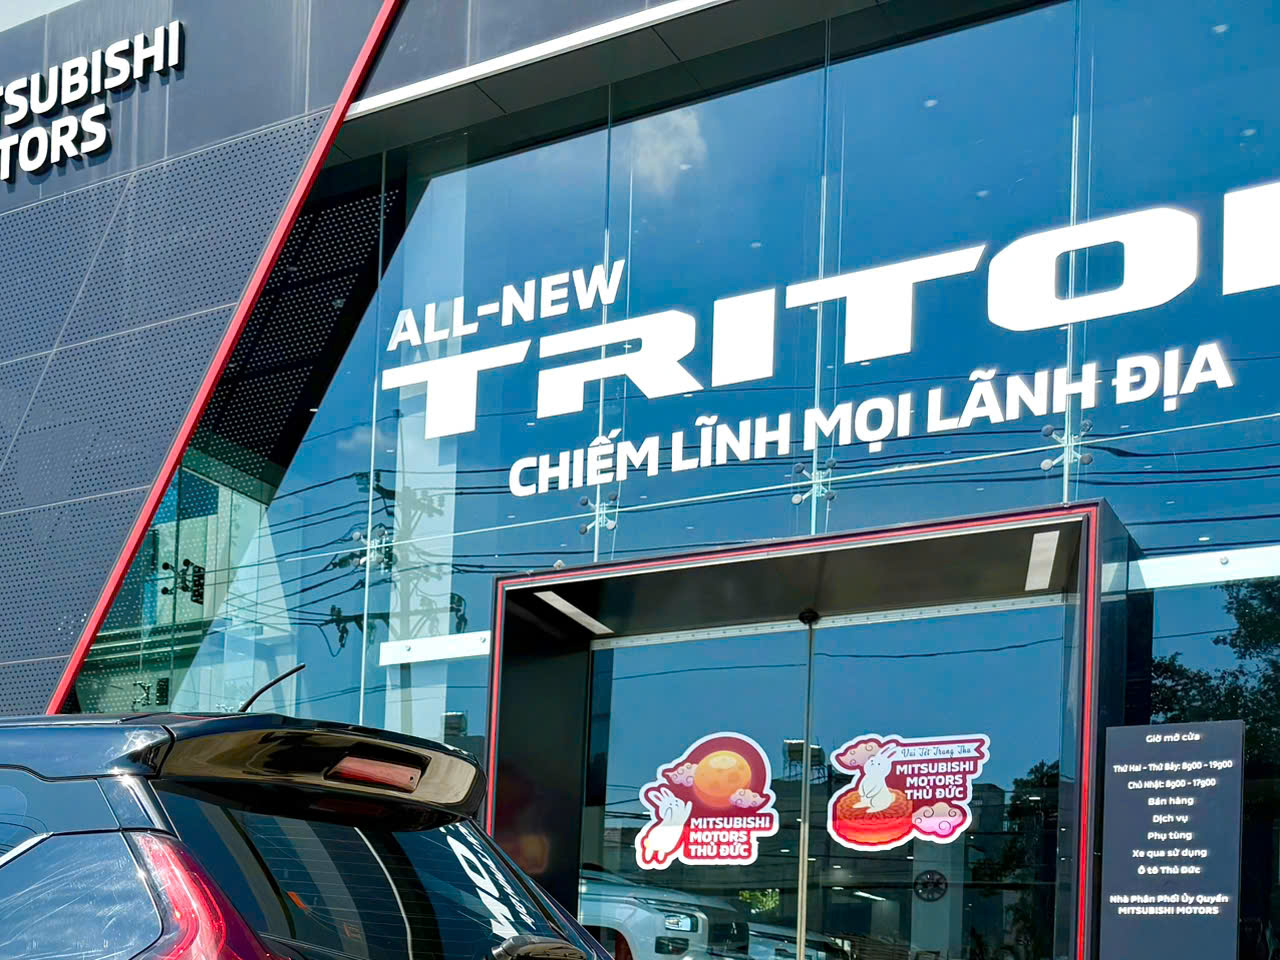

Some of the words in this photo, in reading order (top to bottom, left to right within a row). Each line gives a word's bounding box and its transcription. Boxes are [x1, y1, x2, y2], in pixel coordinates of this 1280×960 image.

[382, 180, 1280, 440] TRITO
[387, 259, 625, 351] ALL-NEW
[509, 428, 659, 497] CHIẾM
[671, 415, 791, 472] LĨNH
[804, 393, 911, 453] MỌI
[927, 368, 1098, 433] LÃNH
[1112, 342, 1235, 413] ĐỊA
[896, 761, 974, 775] MITSUBISHI
[1129, 764, 1142, 772] Hai
[1209, 760, 1233, 770] 19g00
[906, 775, 963, 787] MOTORS
[1192, 778, 1216, 788] 17g00
[905, 785, 932, 800] THỦ
[935, 785, 964, 799] ĐỨC
[1148, 797, 1167, 806] Bán
[1169, 796, 1195, 806] hàng
[691, 816, 770, 829] MITSUBISHI
[1152, 814, 1174, 824] Dịch
[1176, 815, 1189, 823] vụ
[690, 831, 748, 842] MOTORS
[1147, 832, 1167, 841] Phụ
[1168, 831, 1193, 841] tùng
[688, 841, 717, 856] THỦ
[720, 841, 749, 856] ĐỨC
[1146, 850, 1165, 858] qua
[1167, 848, 1181, 857] sử
[1181, 848, 1207, 858] dụng
[1147, 866, 1159, 874] tô
[1118, 906, 1175, 915] MITSUBISHI
[1176, 906, 1220, 915] MOTORS
